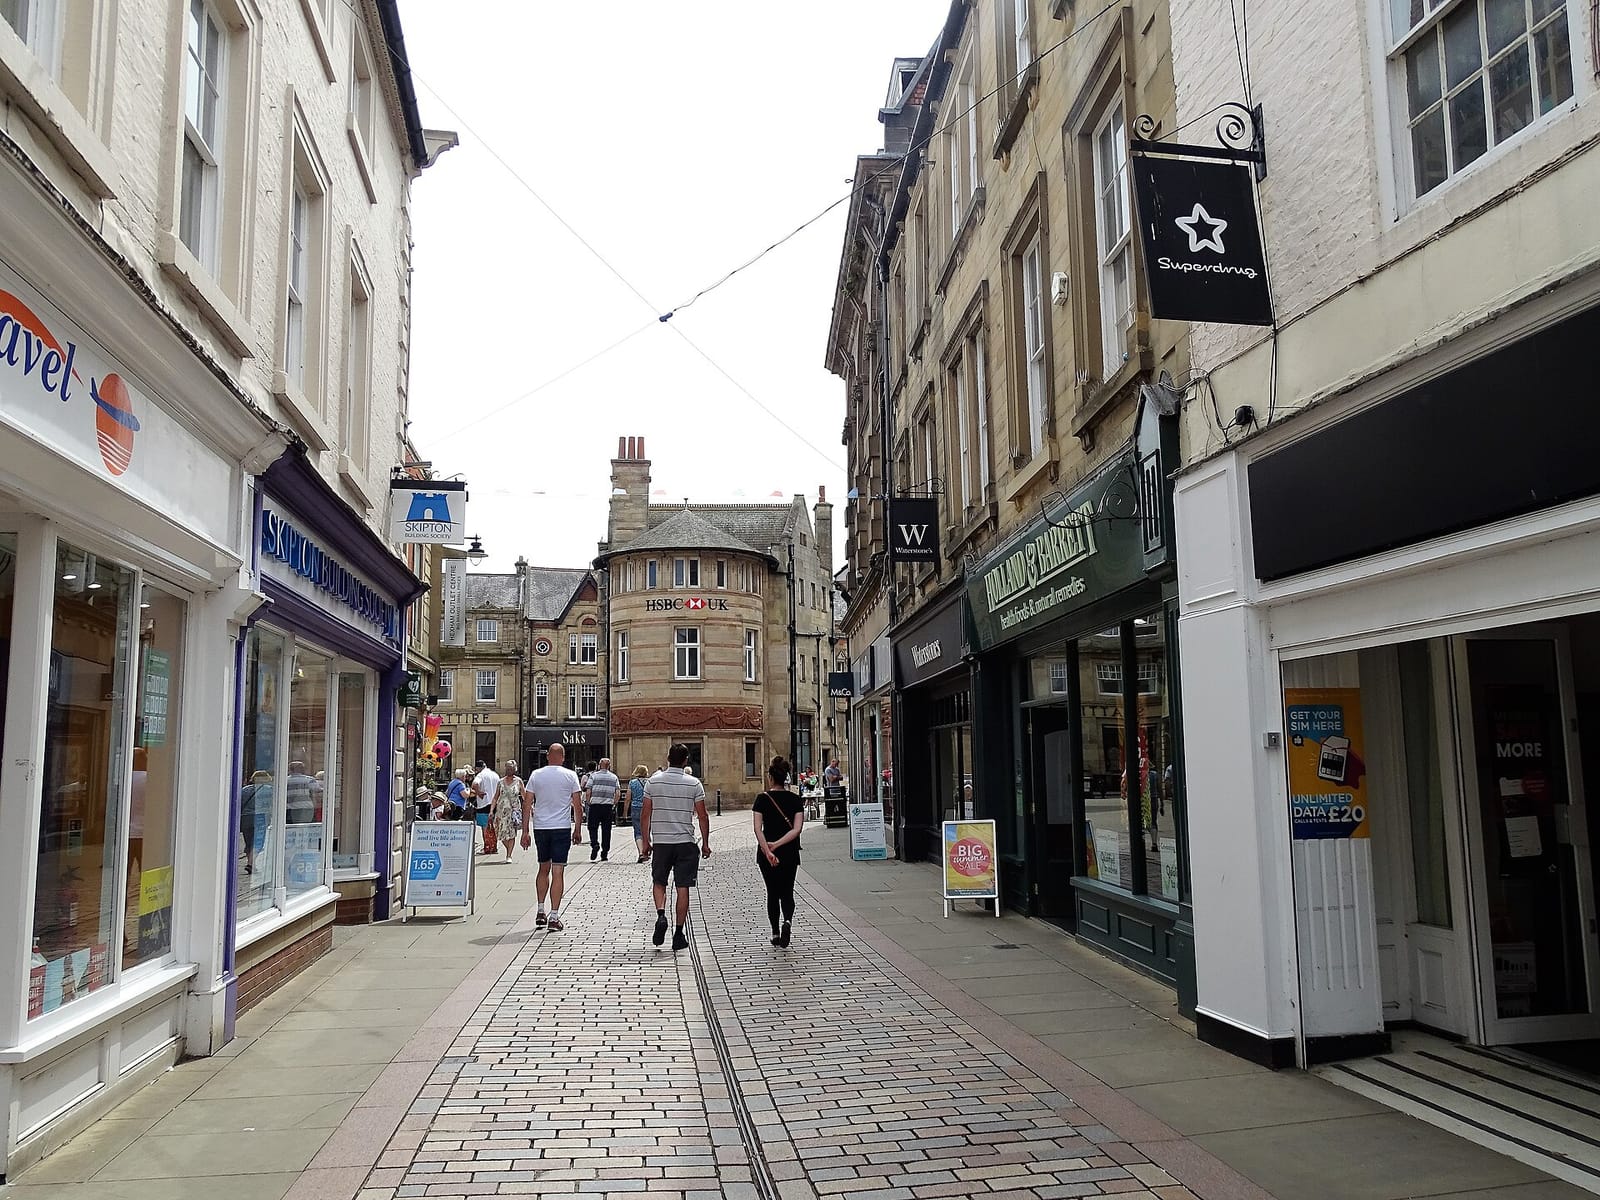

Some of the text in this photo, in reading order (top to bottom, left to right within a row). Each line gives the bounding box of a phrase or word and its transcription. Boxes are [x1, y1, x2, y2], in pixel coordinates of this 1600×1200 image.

[1158, 257, 1258, 279] Superdrug
[405, 522, 452, 533] SKIPTON
[898, 524, 928, 546] W
[264, 510, 321, 585] SKIPTON
[984, 499, 1098, 613] HOLLAND & BARRETT
[646, 598, 729, 611] HSBC UK
[1290, 711, 1341, 720] GET YOUR
[1290, 722, 1342, 731] SIM HERE
[562, 730, 586, 744] Saks
[1496, 742, 1543, 758] MORE
[1292, 793, 1354, 804] UNLIMITED
[1293, 806, 1327, 818] DATA
[1328, 805, 1366, 823] £20
[958, 845, 983, 857] BIG
[413, 859, 435, 870] 1.65
[953, 854, 989, 863] summer
[959, 861, 981, 870] SALE
